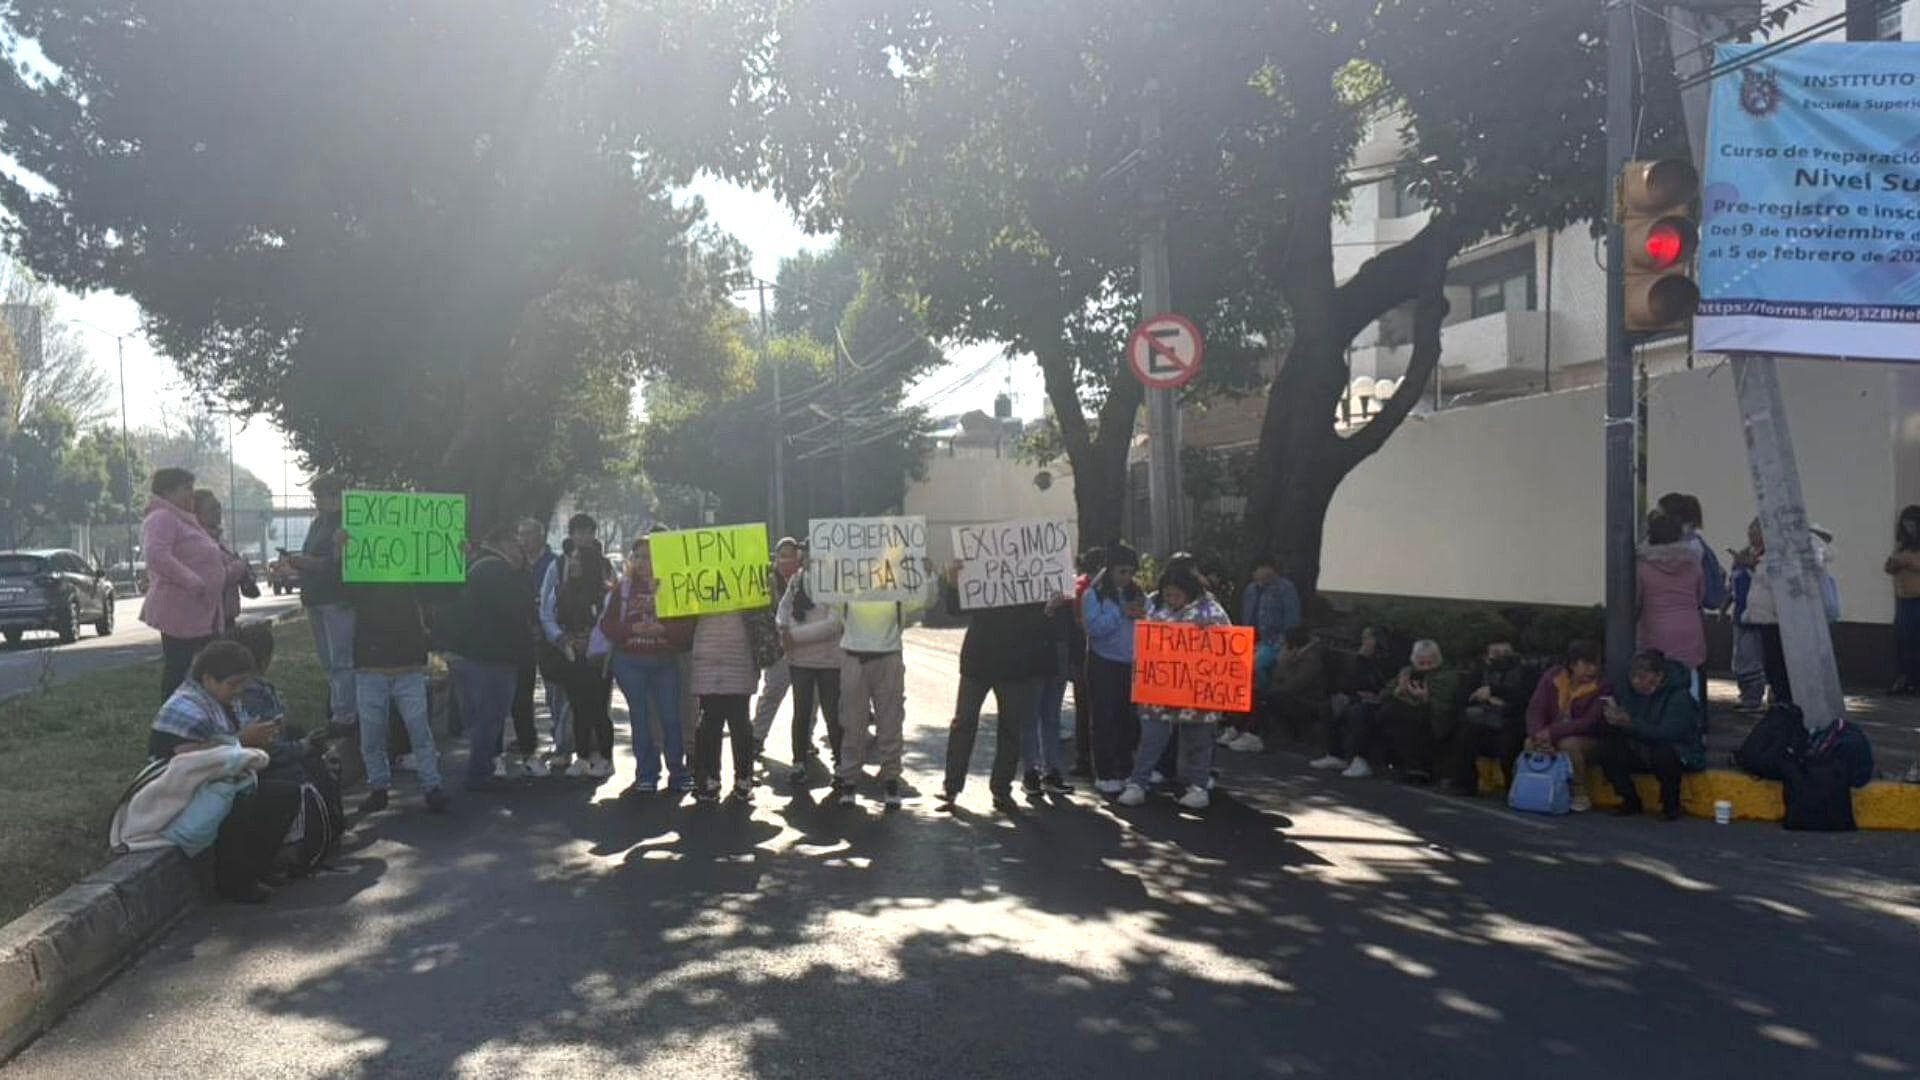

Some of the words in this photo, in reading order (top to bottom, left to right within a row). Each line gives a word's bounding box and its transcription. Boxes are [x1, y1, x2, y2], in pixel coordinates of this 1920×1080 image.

[1803, 73, 1915, 88] INSTITUTO
[1803, 99, 1859, 110] Escuela
[1721, 144, 1777, 158] Curso
[1783, 144, 1808, 159] de
[1795, 168, 1871, 190] Nivel
[1713, 199, 1849, 219] Pre-registro
[1857, 205, 1869, 217] e
[1711, 224, 1736, 236] Del
[1741, 223, 1754, 237] 9
[1760, 225, 1780, 238] de
[1786, 225, 1906, 241] noviembre
[1708, 247, 1722, 259] al
[1729, 246, 1740, 259] 5
[1747, 247, 1767, 259] de
[1774, 247, 1855, 262] febrero
[1861, 250, 1883, 263] de
[1148, 328, 1182, 374] E
[346, 495, 465, 532] EXIGIMOS
[681, 530, 736, 566] IPN
[812, 522, 926, 553] GOBIERNO
[958, 521, 1067, 561] EXIGIMOS
[344, 536, 408, 570] PAGO
[411, 530, 464, 576] IPN
[1137, 623, 1249, 657] TRABAJO
[1134, 660, 1194, 689] HASTA
[1195, 658, 1248, 680] QUE
[1194, 678, 1247, 707] PAGUE
